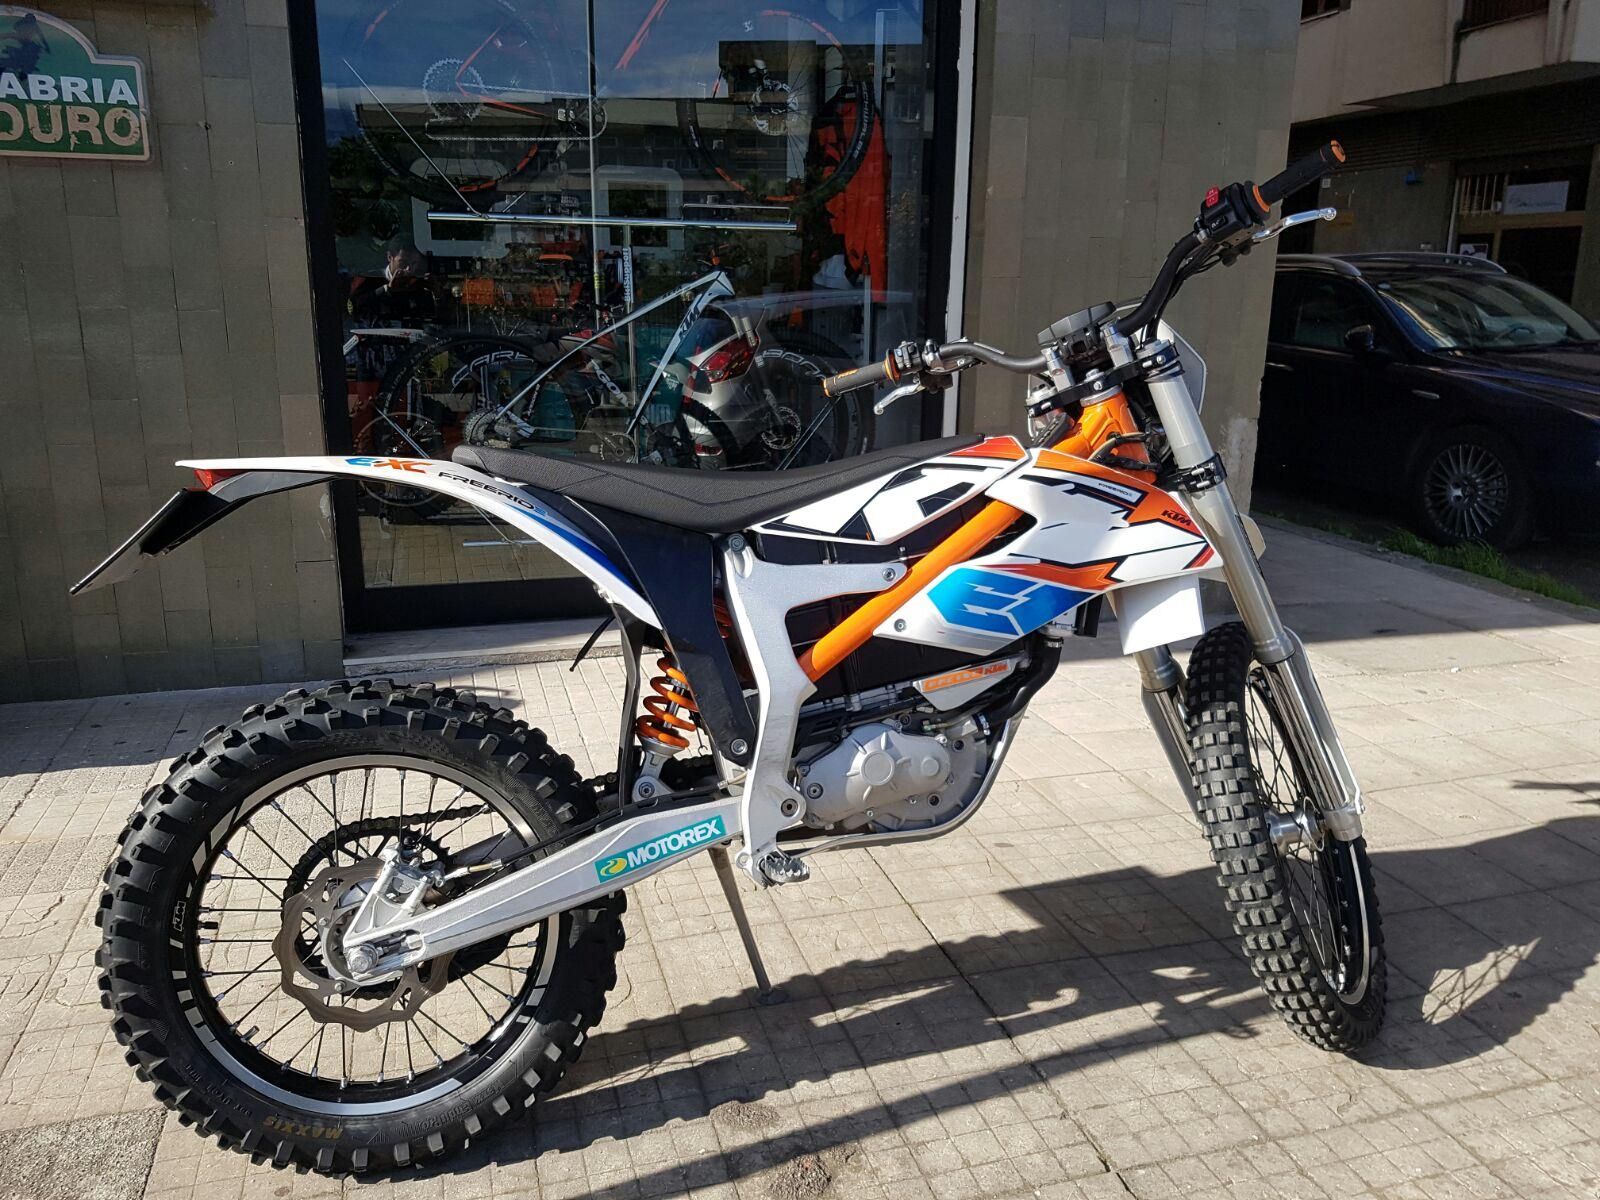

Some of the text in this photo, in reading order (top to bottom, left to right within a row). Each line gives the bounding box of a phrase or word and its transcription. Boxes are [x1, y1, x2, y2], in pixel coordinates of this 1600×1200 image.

[0, 72, 138, 105] ABRIA
[679, 305, 701, 341] KTM
[1161, 509, 1192, 526] KTM
[627, 819, 721, 868] MOTOREX
[263, 1115, 343, 1140] MAXXIS
